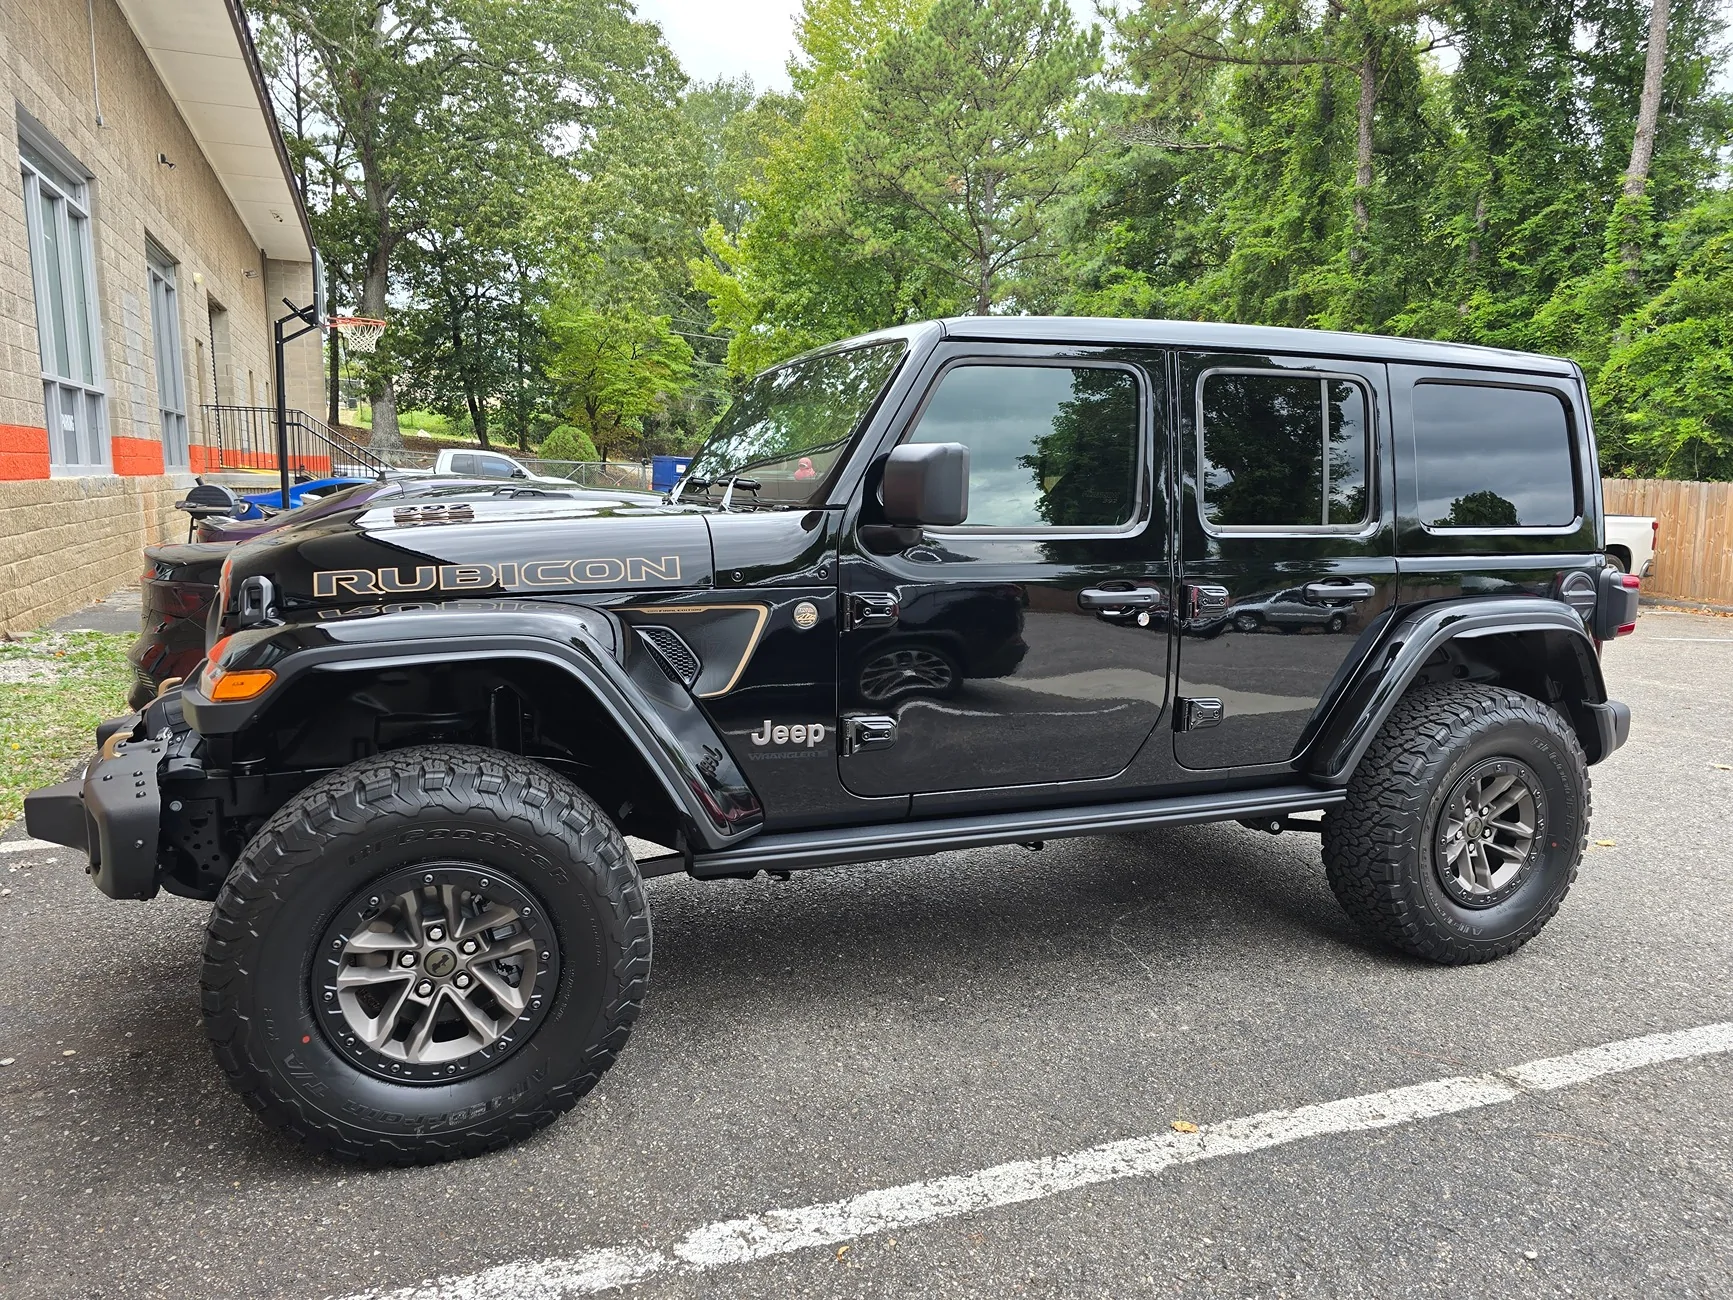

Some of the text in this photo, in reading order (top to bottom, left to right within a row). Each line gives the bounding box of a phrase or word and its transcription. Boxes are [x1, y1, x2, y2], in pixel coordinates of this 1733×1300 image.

[313, 555, 682, 597] RUBICON
[751, 719, 825, 748] Jeep
[747, 750, 817, 761] WRANGLER
[347, 828, 570, 886] BFGoodrich
